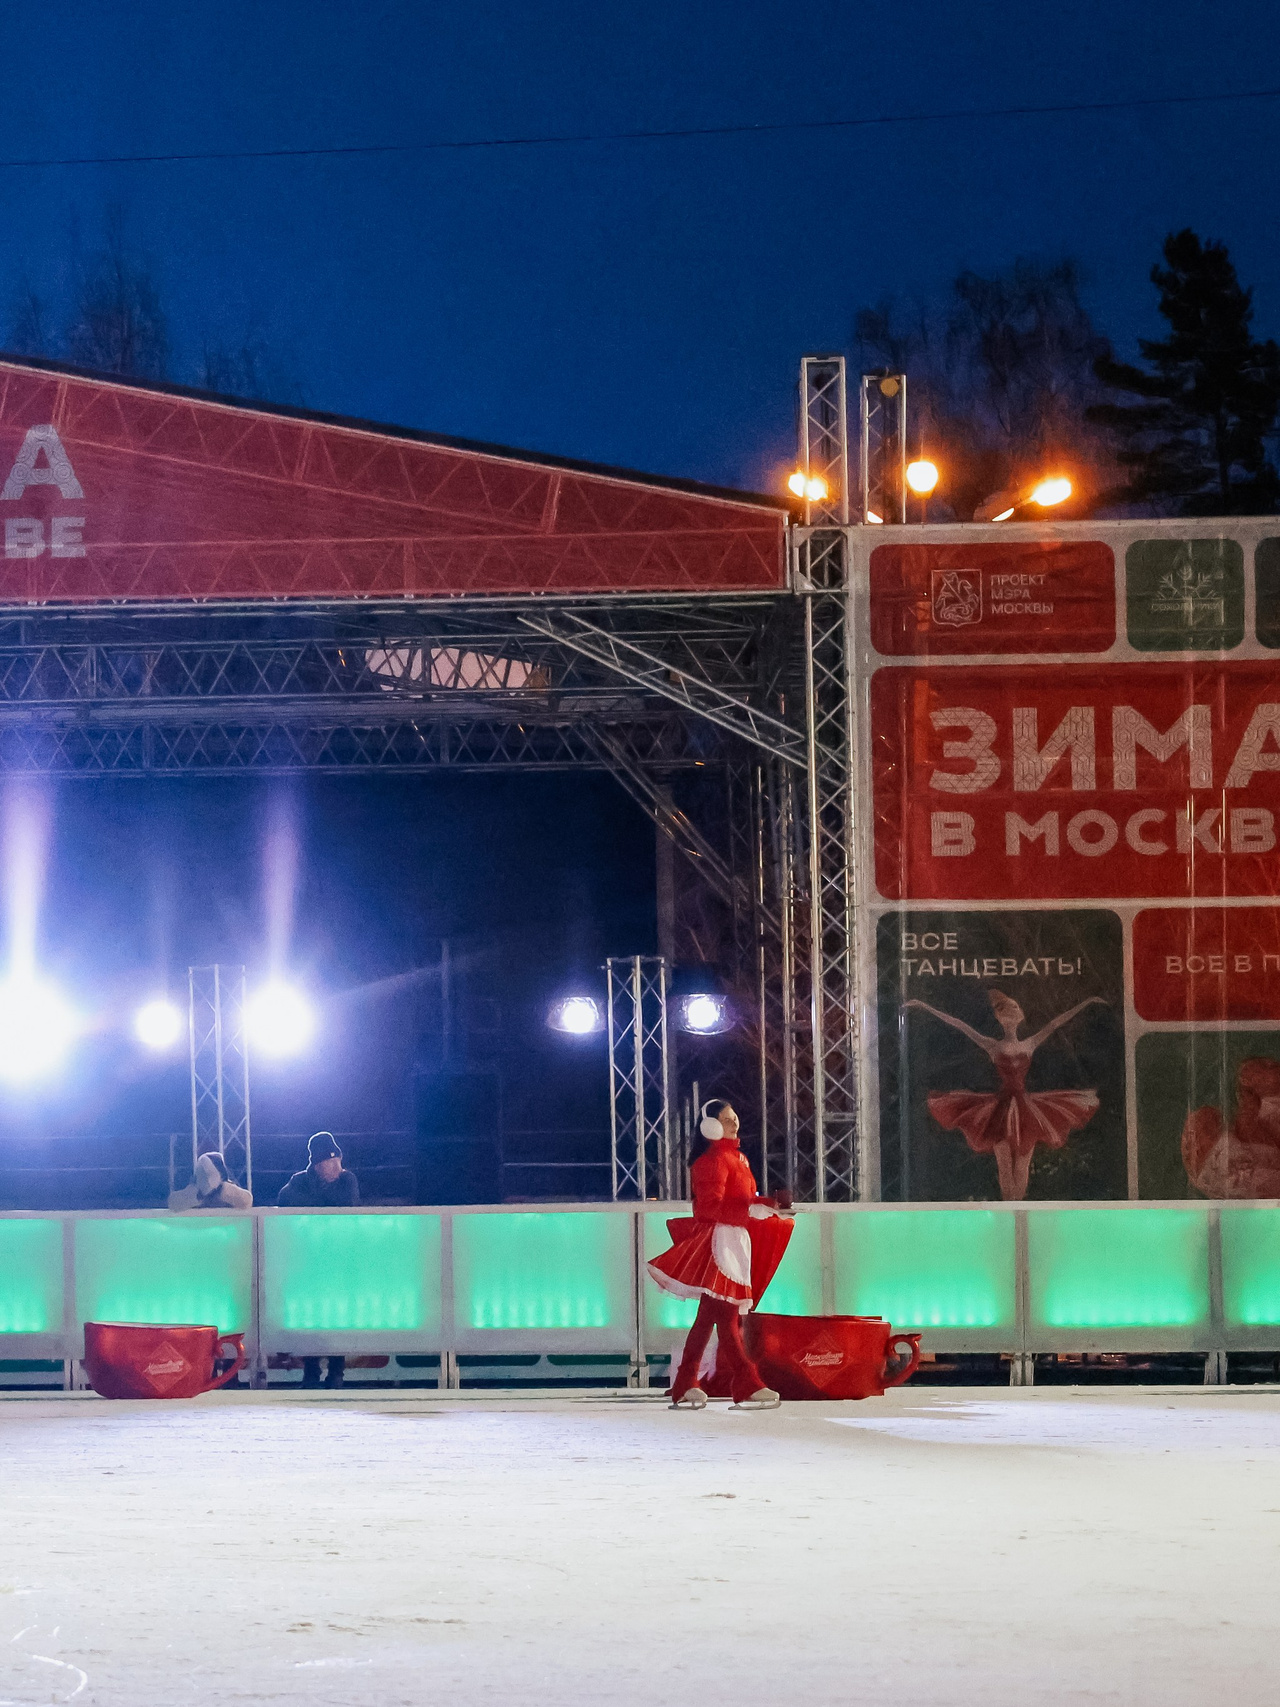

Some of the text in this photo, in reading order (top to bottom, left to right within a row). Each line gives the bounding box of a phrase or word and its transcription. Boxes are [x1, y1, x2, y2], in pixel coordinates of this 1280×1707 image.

[991, 574, 1046, 587] ПРОЕКТ
[991, 602, 1054, 615] МОСКВЫ
[929, 703, 1280, 794] ЗИМА
[931, 811, 977, 857] В
[901, 933, 959, 951] ВСЕ
[901, 956, 1083, 979] ТАНЦЕВАТЬ!
[1166, 955, 1225, 973] ВСЕ
[1234, 955, 1253, 973] В
